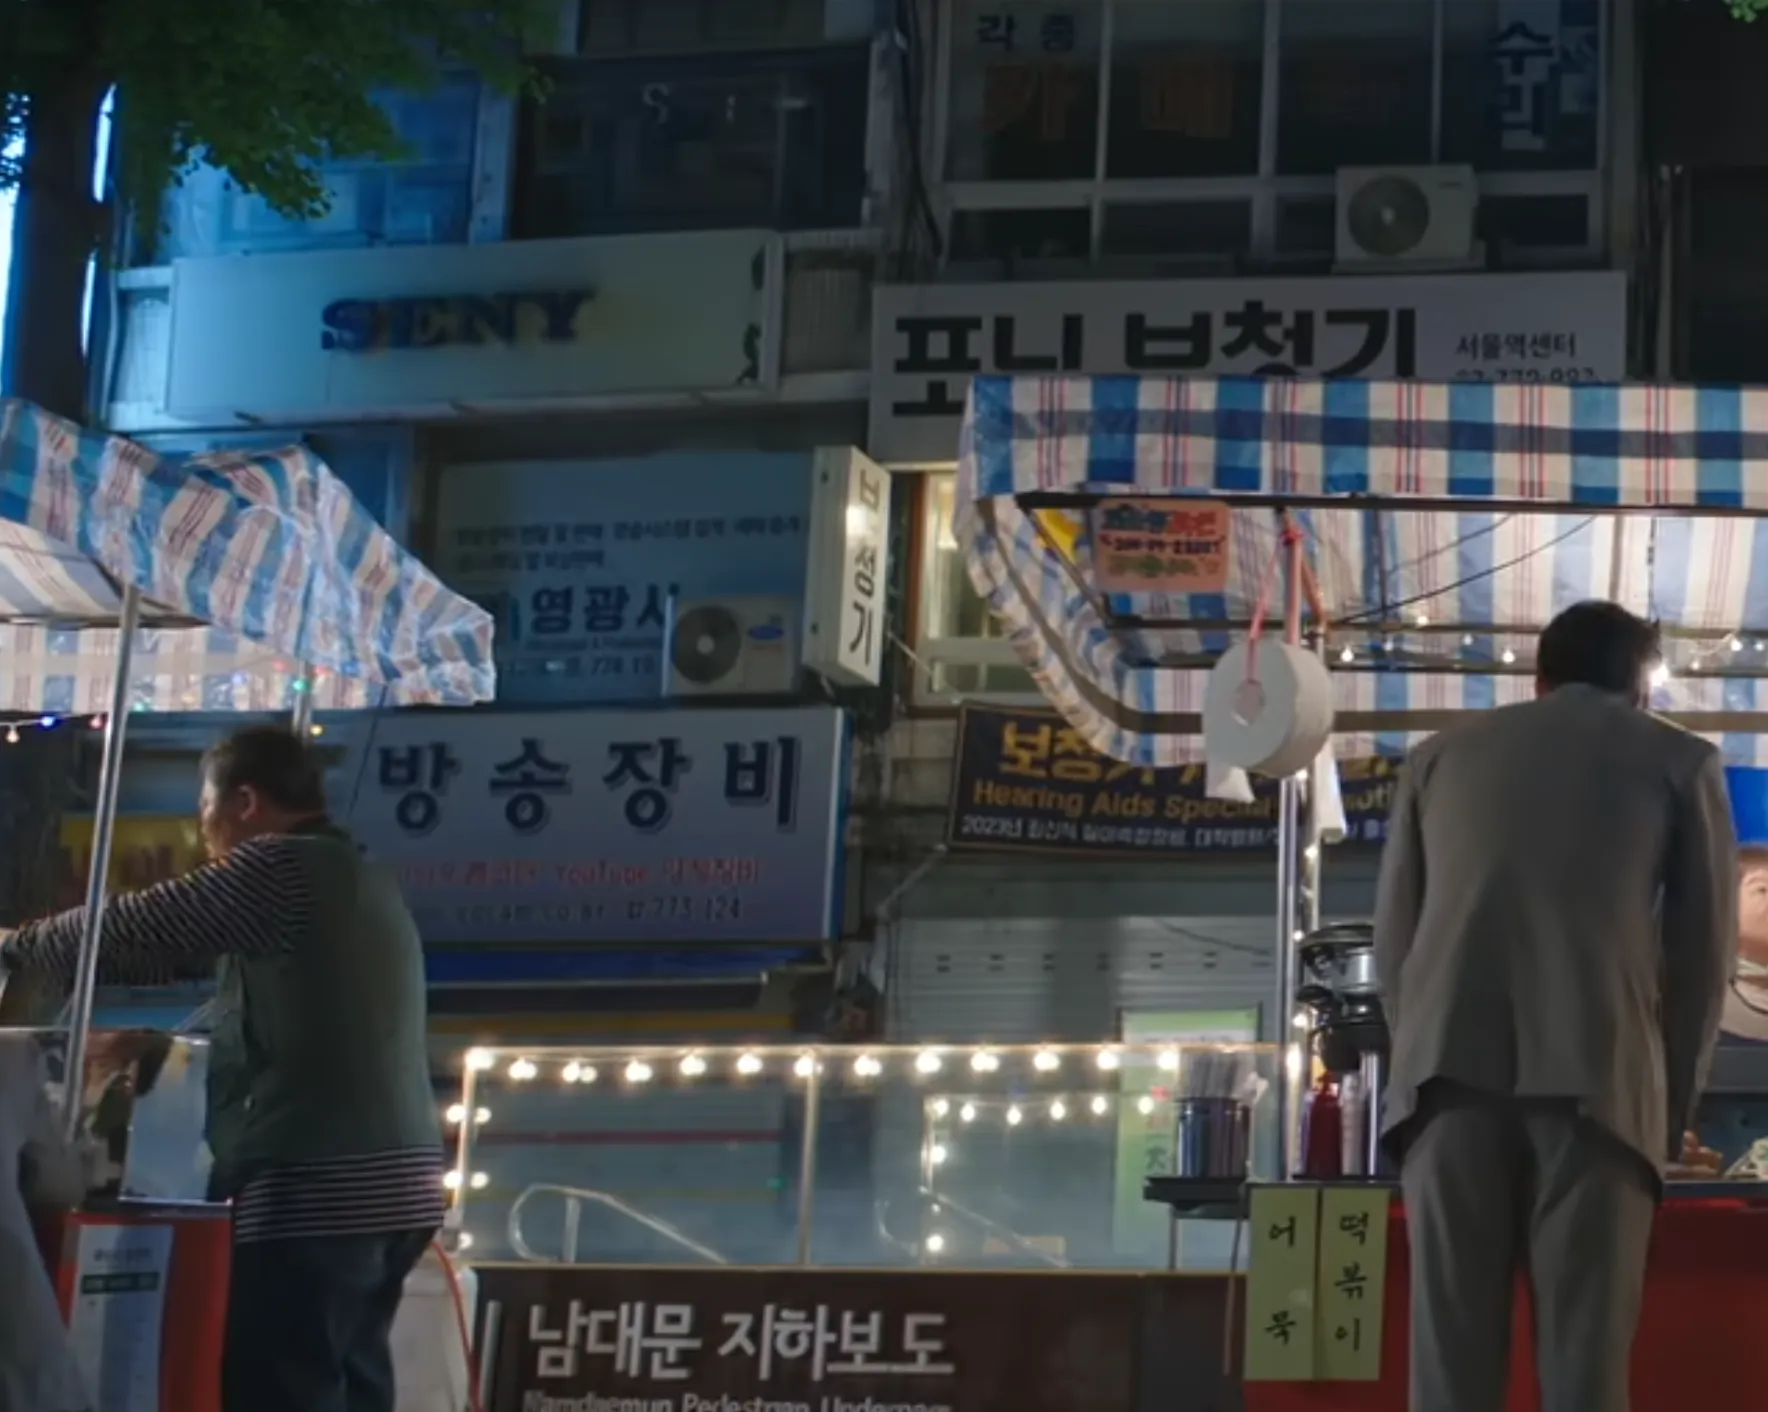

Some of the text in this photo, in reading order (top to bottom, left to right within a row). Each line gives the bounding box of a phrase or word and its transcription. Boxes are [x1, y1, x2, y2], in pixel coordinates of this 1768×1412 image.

[378, 736, 801, 836] 방송장비
[973, 780, 1083, 817] Hearing
[1092, 790, 1156, 818] Aids
[1265, 1216, 1296, 1345] 어묵
[1334, 1212, 1370, 1351] 떡볶이
[528, 1300, 954, 1382] 남대문 지하보도
